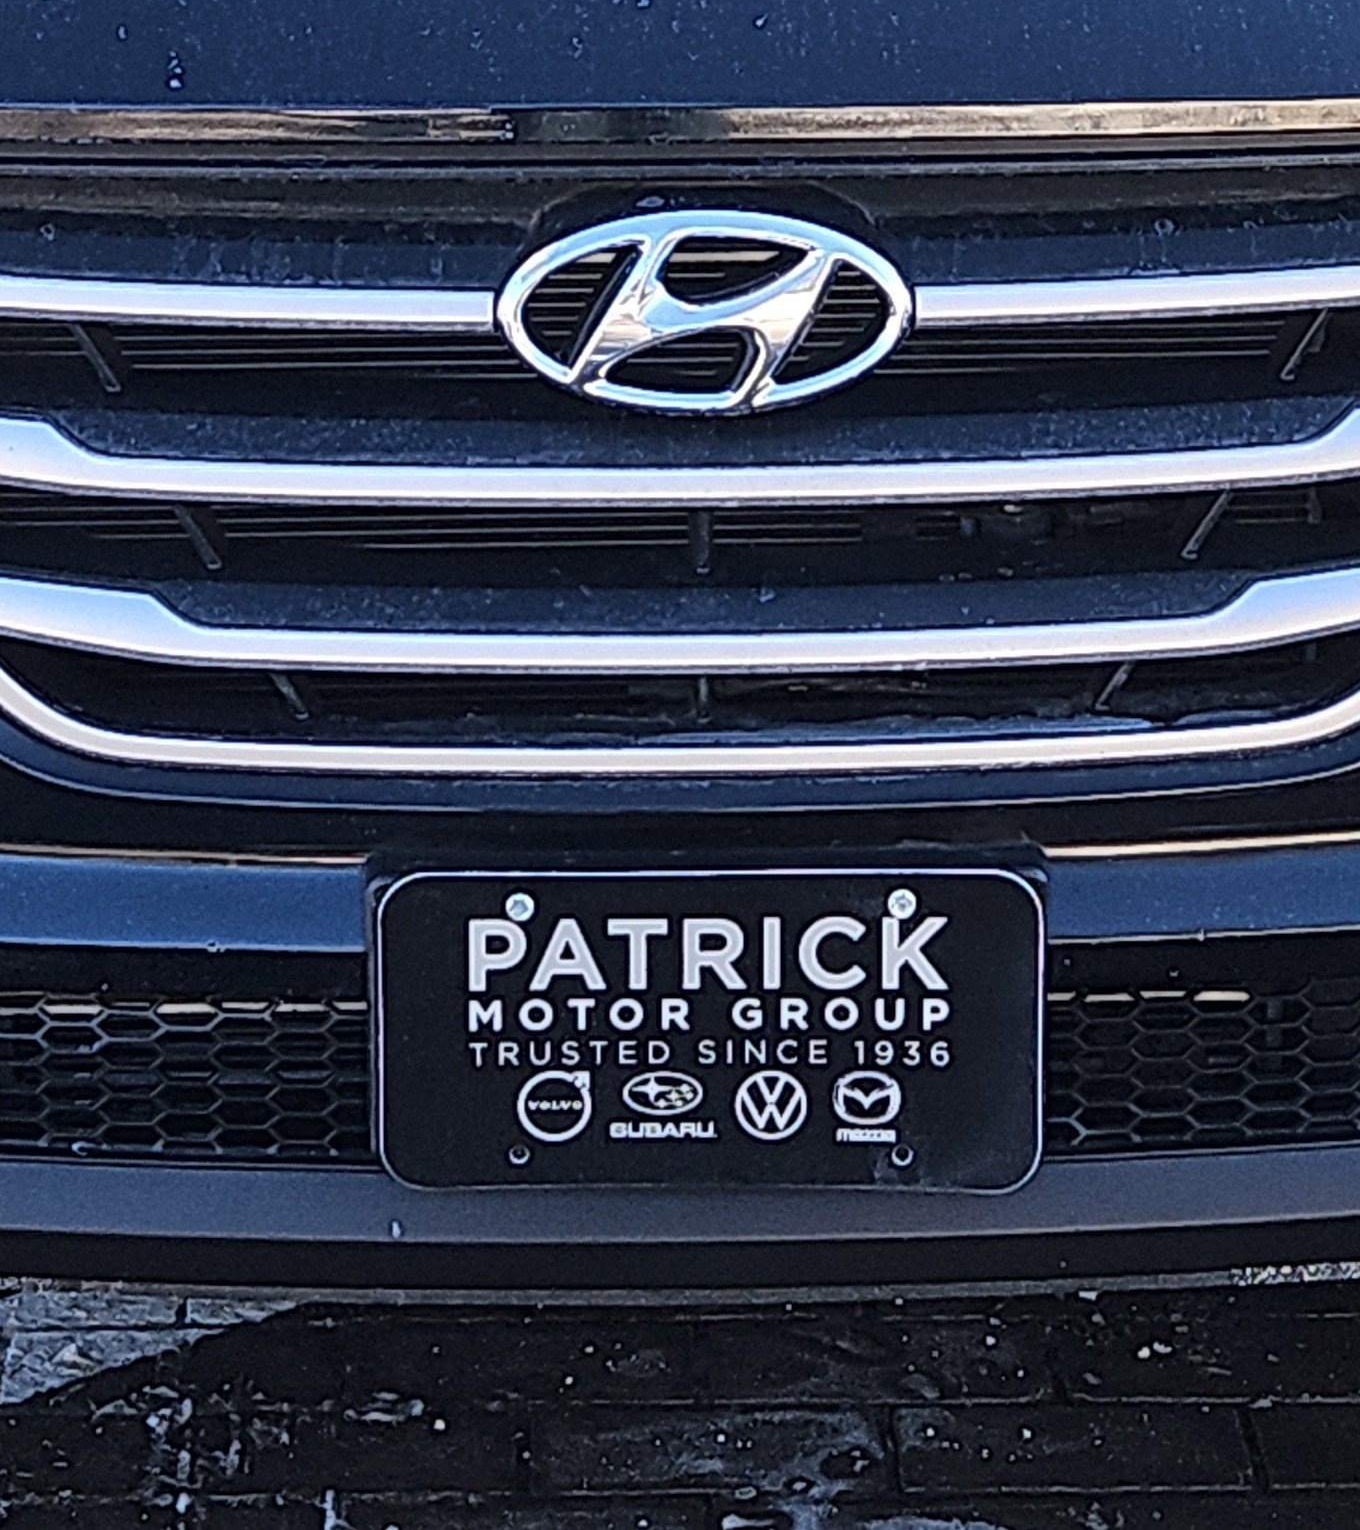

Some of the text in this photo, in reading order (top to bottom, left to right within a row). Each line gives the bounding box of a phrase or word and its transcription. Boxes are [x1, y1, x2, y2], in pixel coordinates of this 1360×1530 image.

[467, 915, 949, 992] PATRICK
[467, 996, 951, 1033] MOTOR GROUP
[468, 1038, 951, 1068] TRUSTED SINCE 1936
[527, 1098, 583, 1112] VOLVO
[608, 1121, 718, 1139] SUBARU
